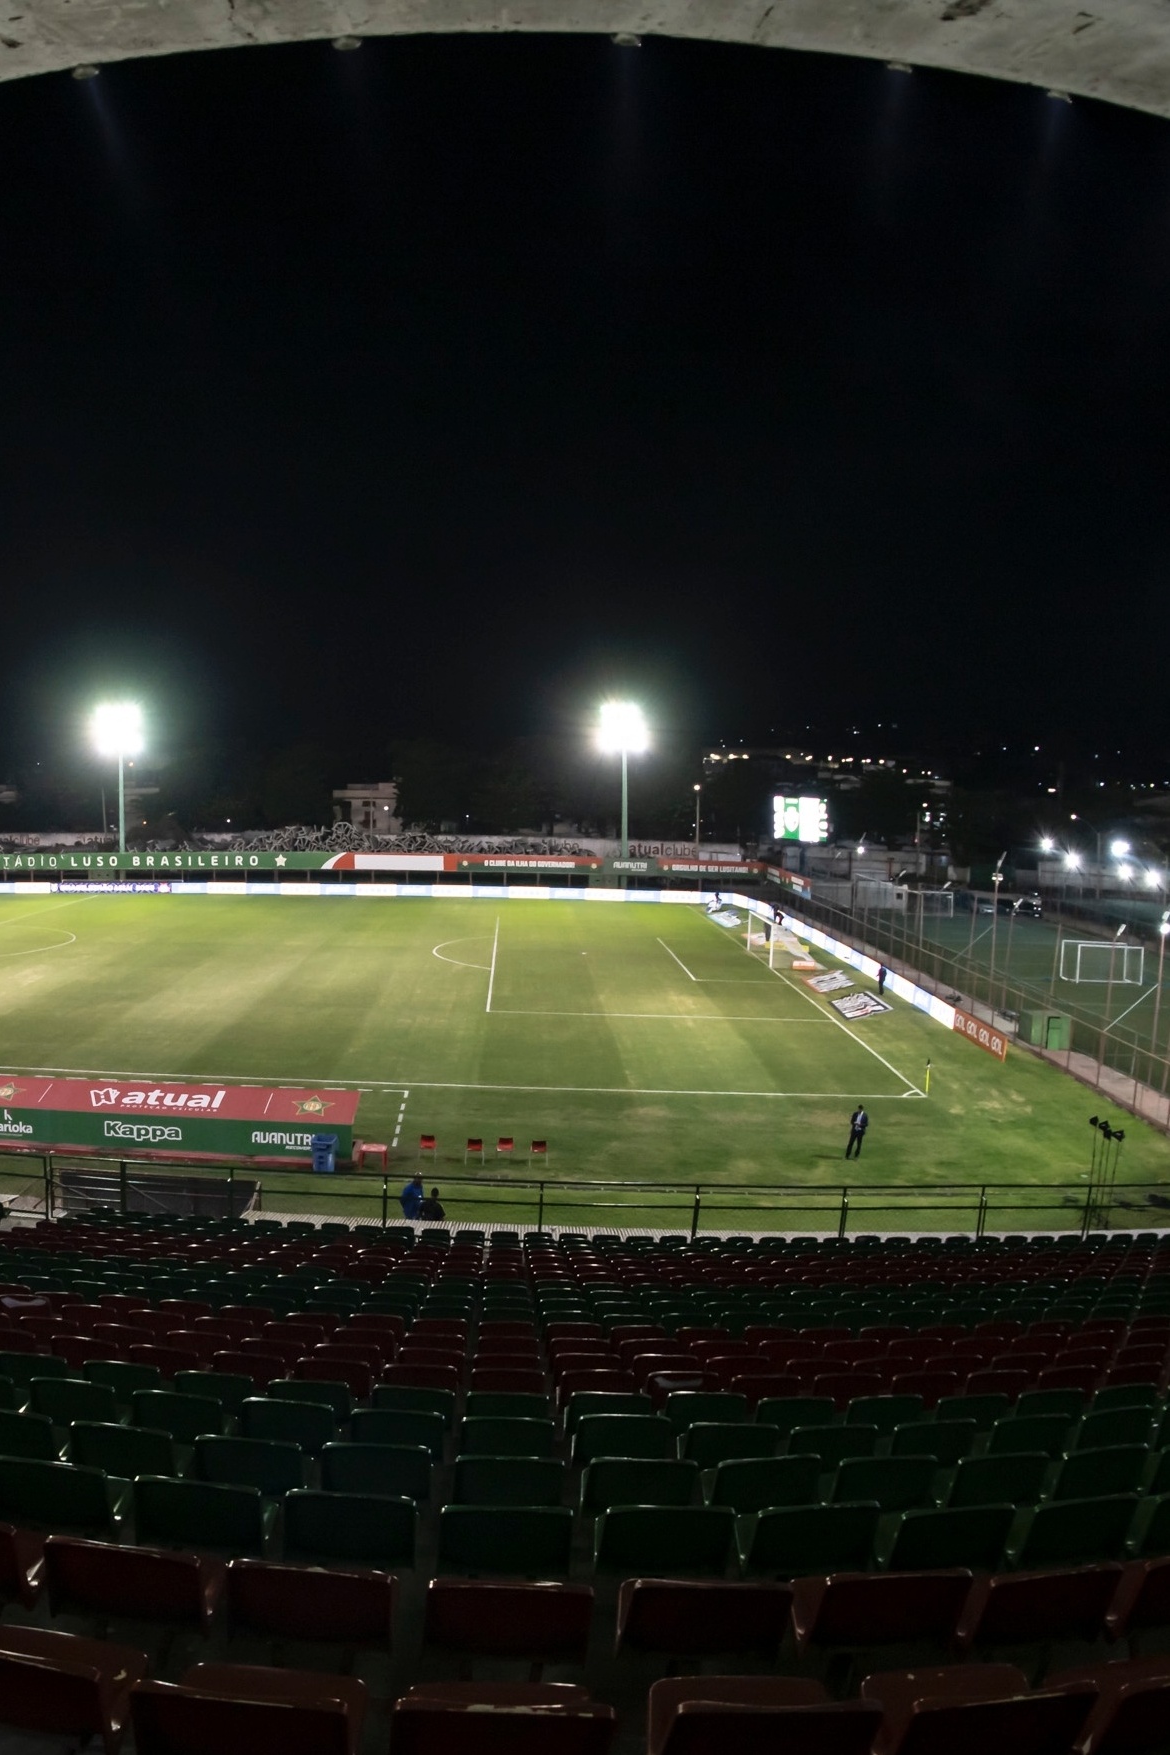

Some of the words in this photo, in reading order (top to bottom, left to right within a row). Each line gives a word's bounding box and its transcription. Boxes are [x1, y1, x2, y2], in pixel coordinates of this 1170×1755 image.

[71, 856, 118, 867] LUSO
[133, 855, 258, 867] BRASILEIRO
[489, 859, 506, 867] CLUBE
[672, 864, 698, 872] ORGULHO
[708, 865, 718, 873] SER
[955, 1014, 966, 1031] GOL
[966, 1020, 977, 1039] GOL
[978, 1028, 990, 1047] GOL
[990, 1036, 1002, 1055] GOL
[121, 1089, 226, 1108] atual
[104, 1121, 182, 1142] Kappa
